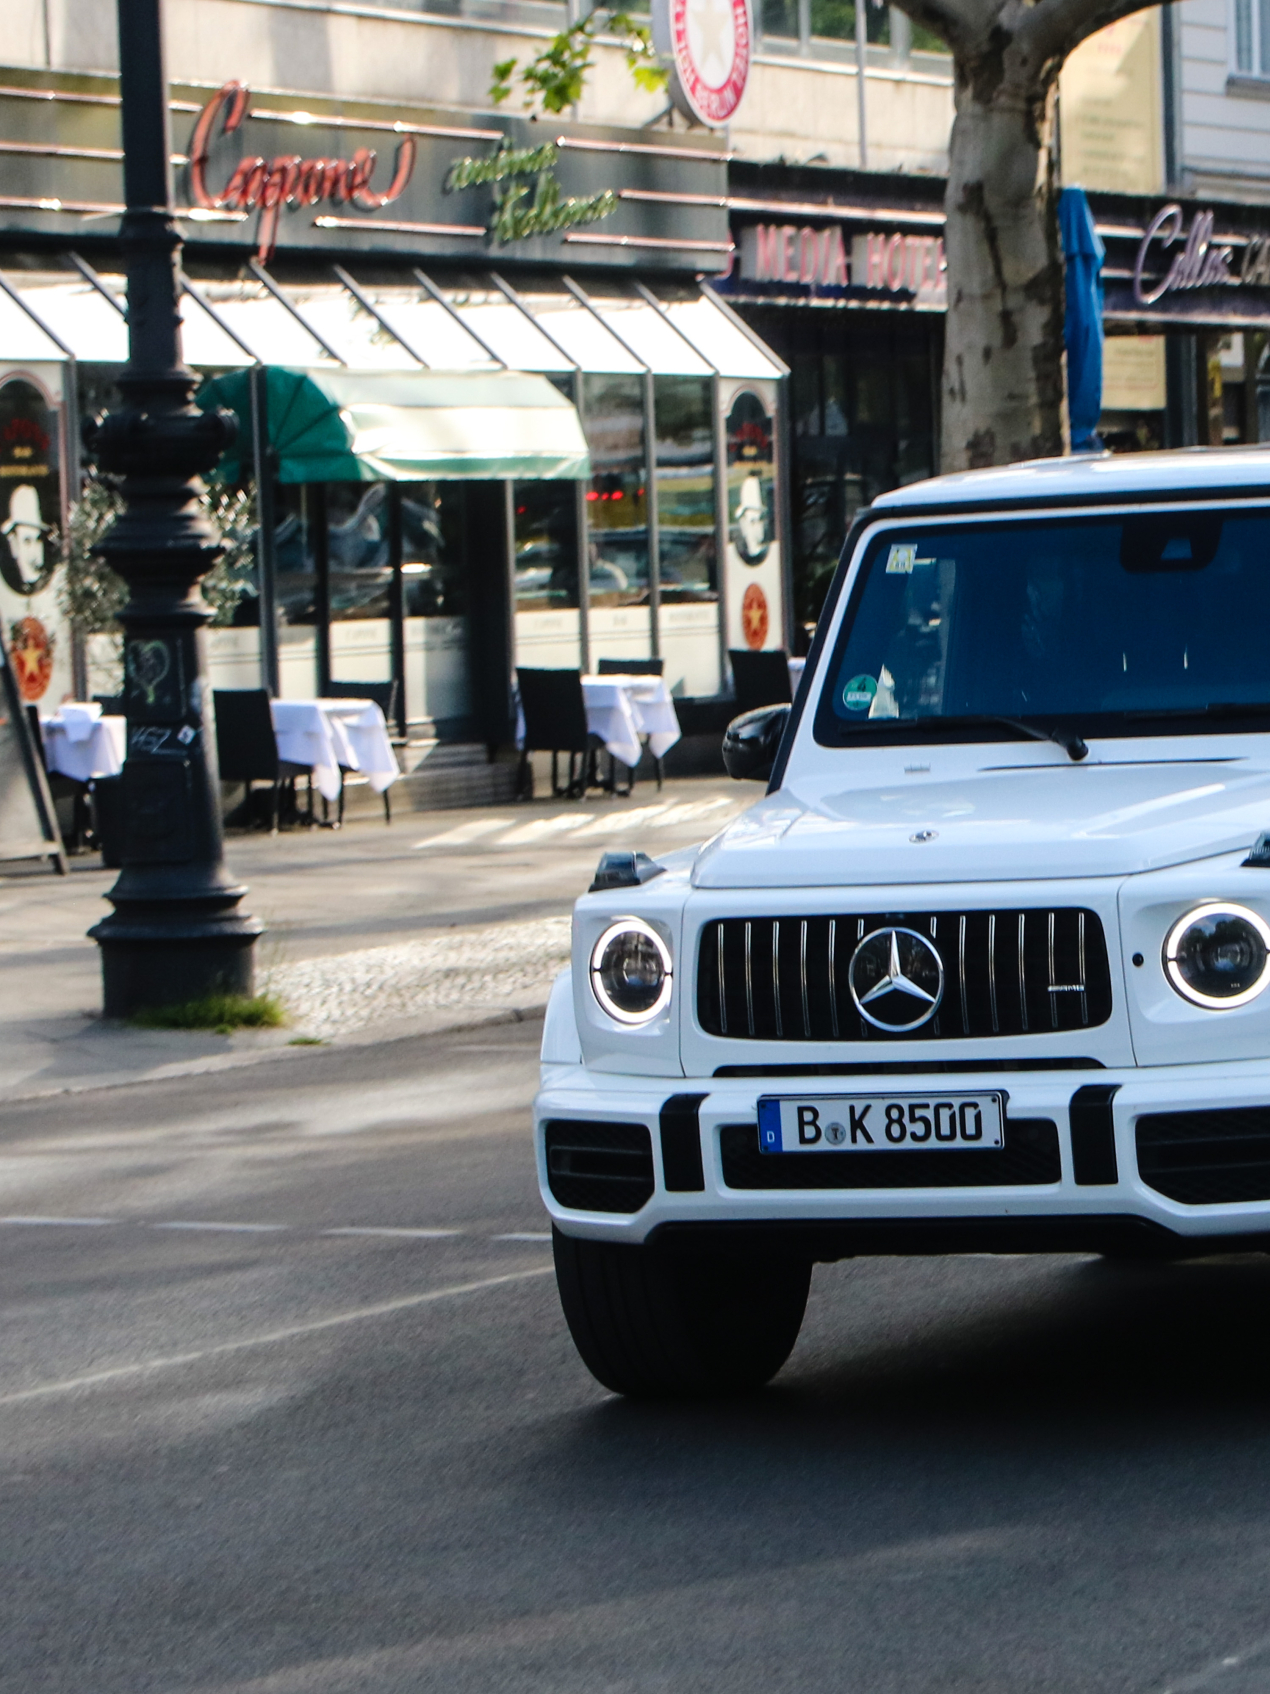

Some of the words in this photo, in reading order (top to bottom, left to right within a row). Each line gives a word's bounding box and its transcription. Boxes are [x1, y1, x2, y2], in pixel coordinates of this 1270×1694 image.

[757, 223, 848, 288] MEDIA
[767, 1131, 775, 1143] D
[797, 1105, 822, 1145] B
[849, 1104, 874, 1144] K
[885, 1101, 983, 1144] 8500
